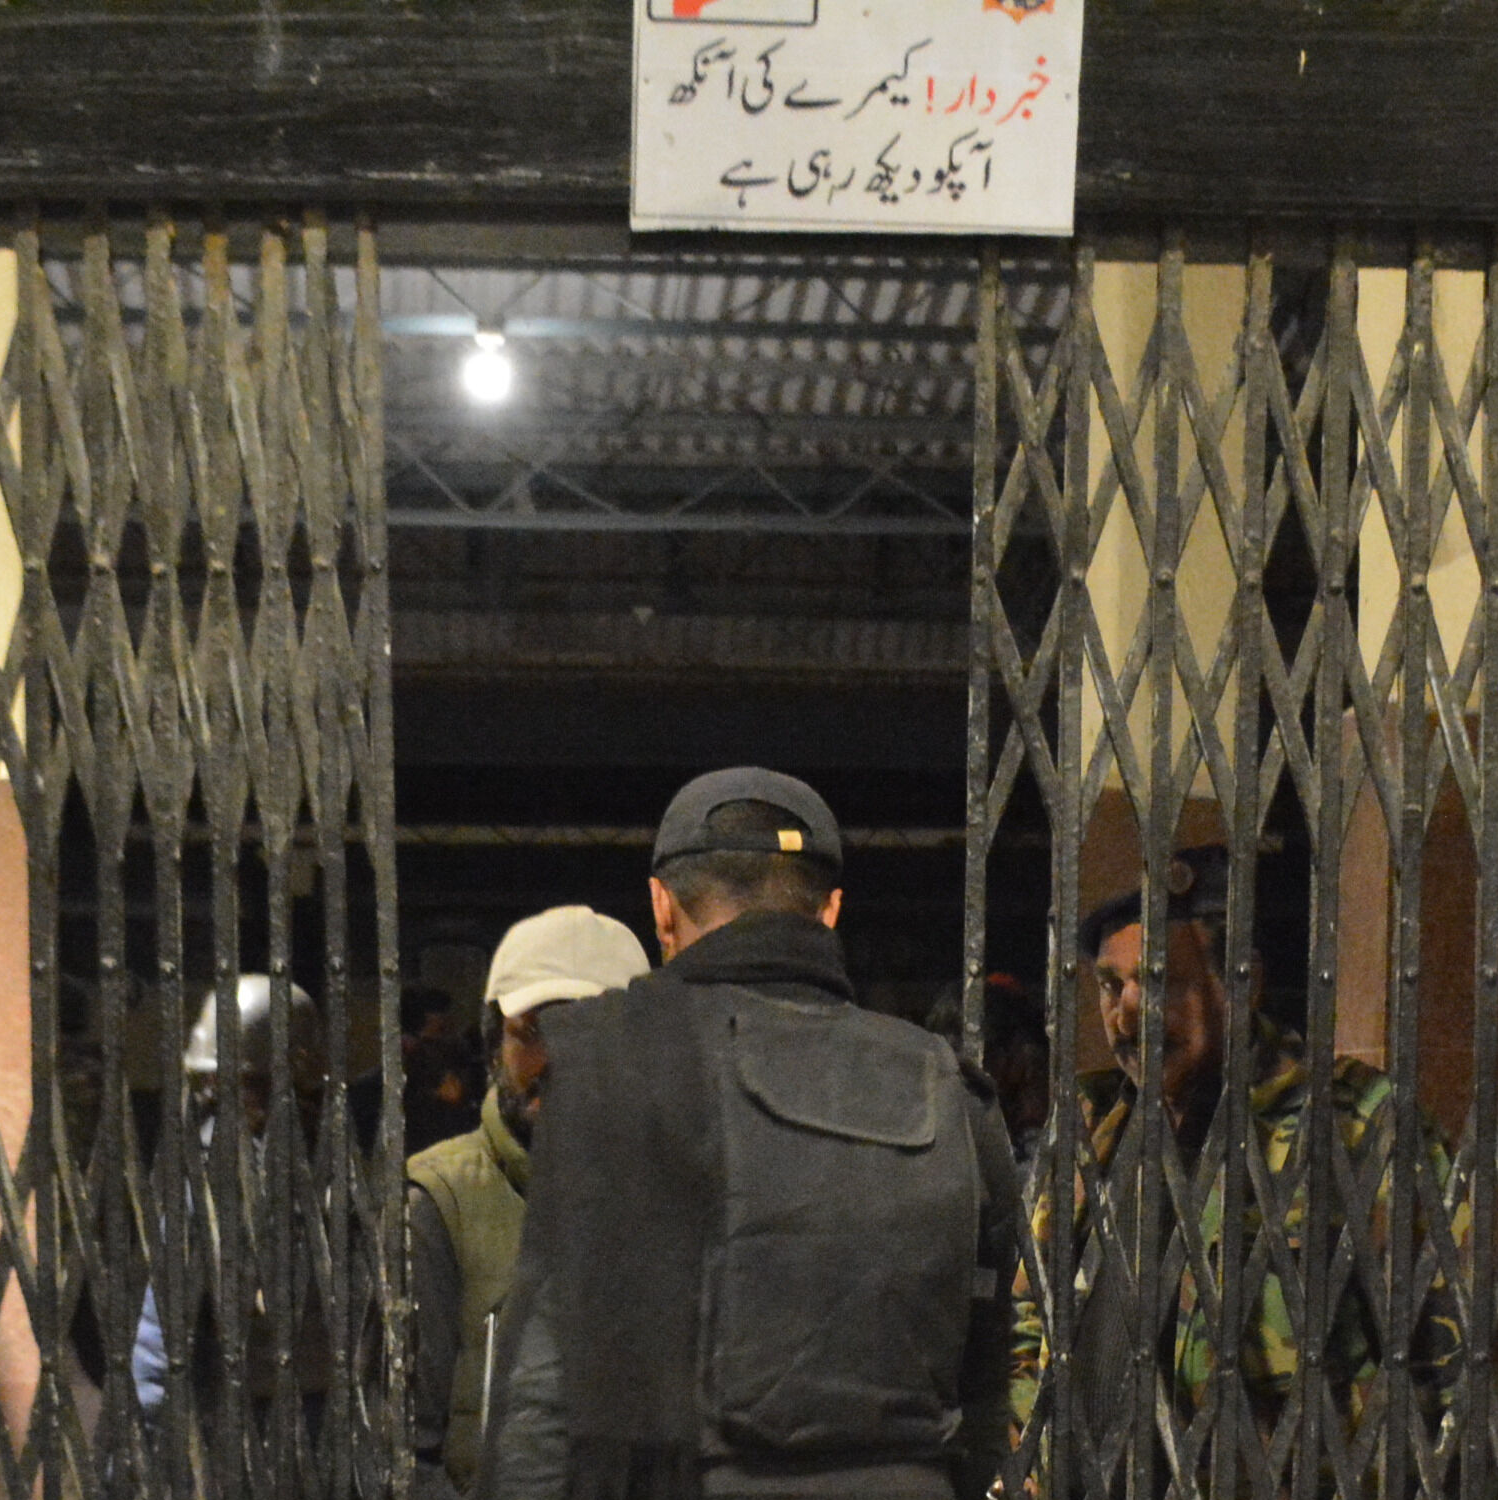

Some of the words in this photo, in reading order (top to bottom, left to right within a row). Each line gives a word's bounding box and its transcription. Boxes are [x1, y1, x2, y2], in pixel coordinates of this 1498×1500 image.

[666, 37, 737, 107] آنکھ
[740, 38, 786, 117] کی
[784, 38, 932, 121] کیمرے
[719, 158, 778, 210] ہے
[787, 148, 857, 205] رہی
[863, 132, 923, 206] دیکھ
